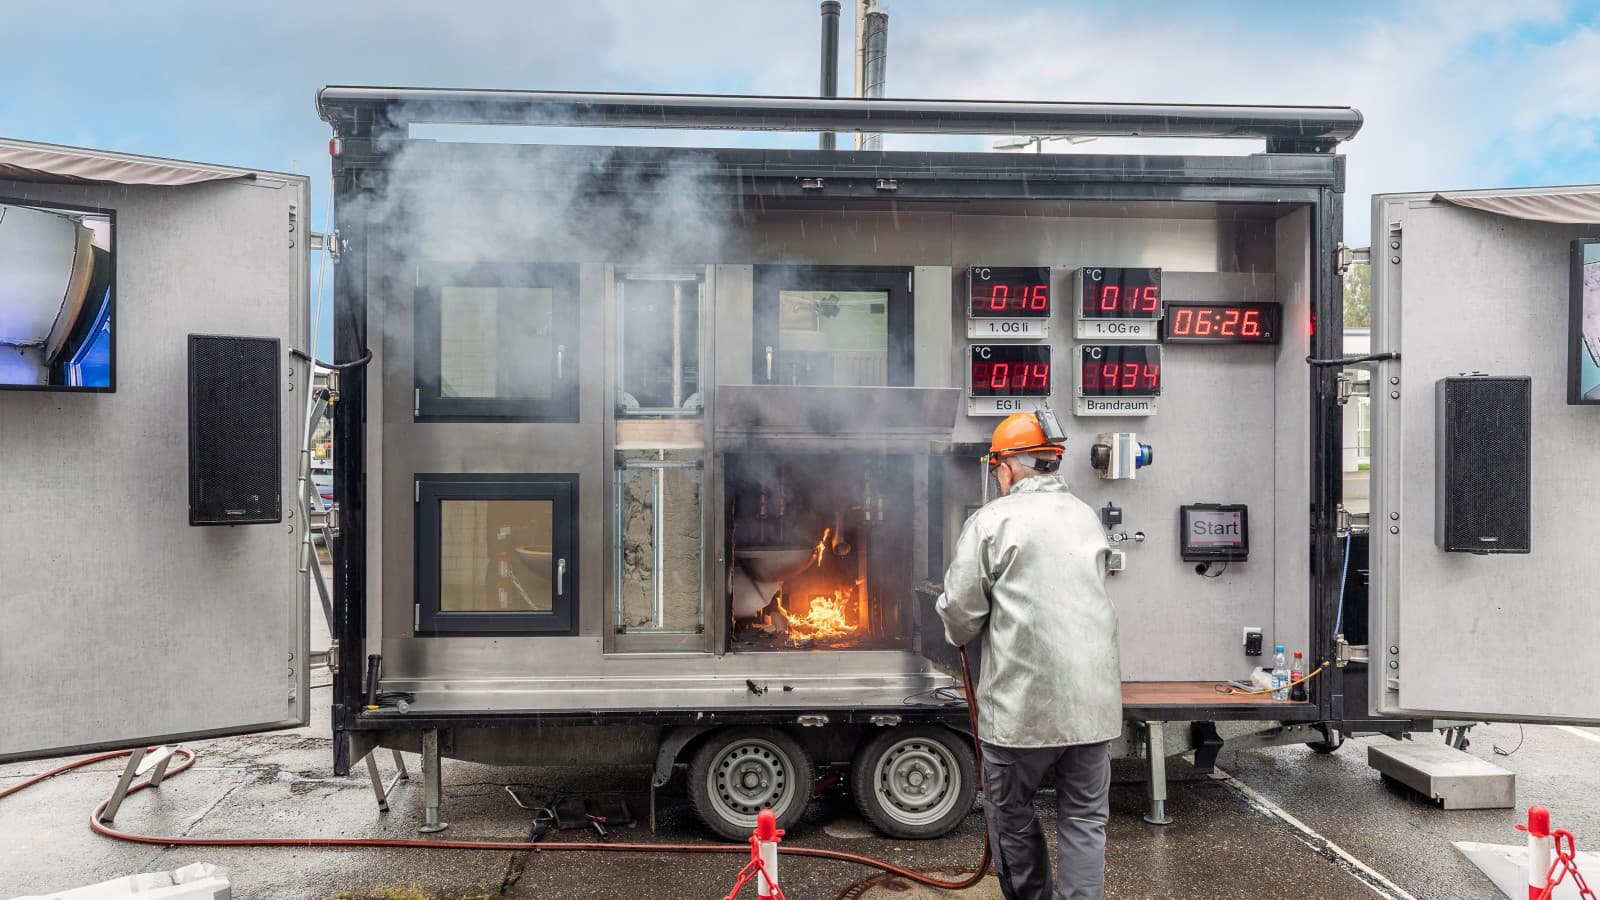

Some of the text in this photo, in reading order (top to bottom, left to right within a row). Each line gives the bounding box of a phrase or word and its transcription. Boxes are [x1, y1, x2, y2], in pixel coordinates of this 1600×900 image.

[975, 268, 991, 280] °C
[1086, 269, 1102, 281] °C
[990, 285, 1048, 310] 016
[1101, 286, 1158, 311] 015
[1129, 325, 1140, 333] re
[975, 346, 992, 359] °C
[1085, 347, 1102, 359] °C
[990, 363, 1049, 388] 014
[1103, 363, 1159, 388] 434
[996, 400, 1012, 410] EG
[1087, 400, 1149, 410] Brandraum
[1193, 520, 1239, 535] Start
